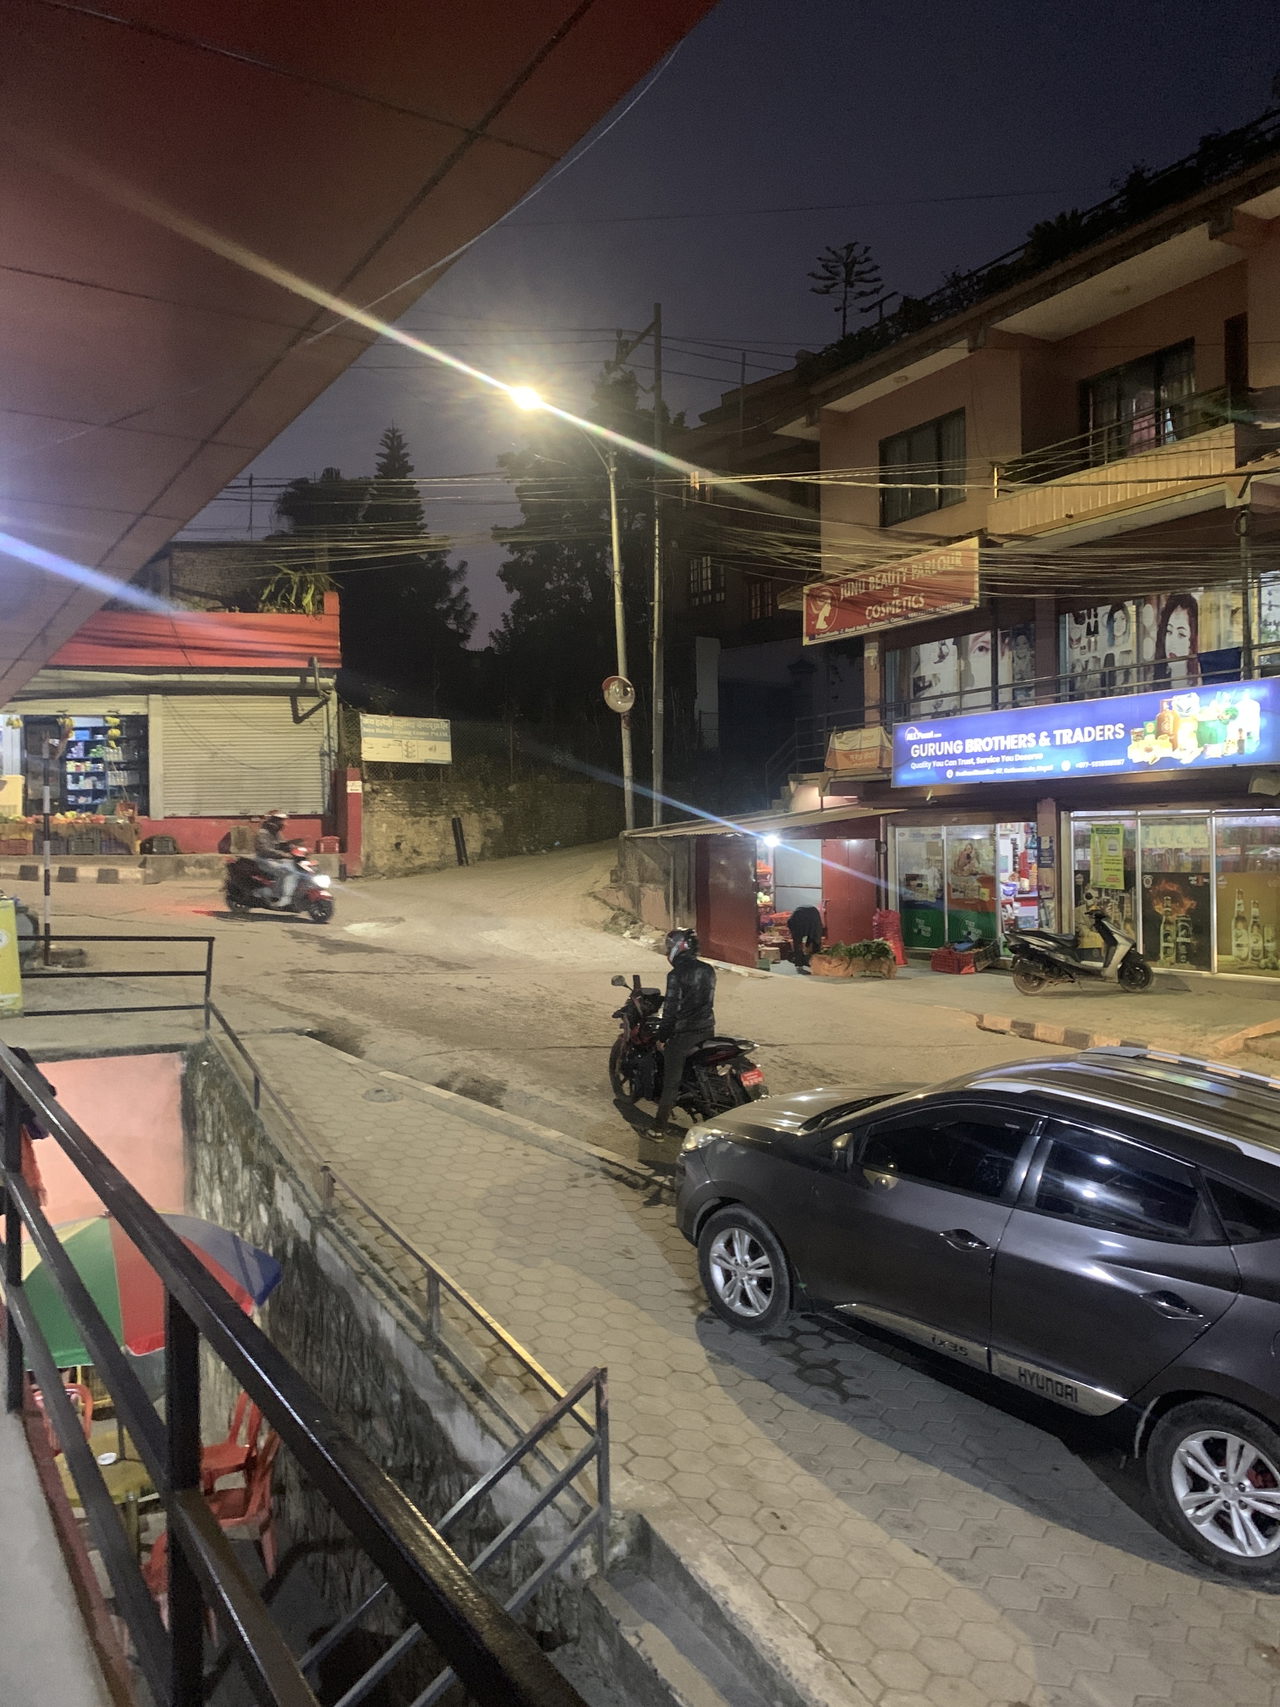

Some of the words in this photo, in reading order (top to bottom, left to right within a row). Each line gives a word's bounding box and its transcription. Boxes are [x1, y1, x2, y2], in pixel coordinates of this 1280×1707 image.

[869, 567, 908, 590] BEAUTY
[865, 594, 925, 620] COSMETICS
[910, 740, 963, 758] GURUNG
[965, 733, 1037, 753] BROTHERS
[1038, 731, 1051, 747] &
[1053, 723, 1125, 746] TRADERS
[910, 761, 932, 770] Quality
[932, 760, 944, 768] You
[944, 759, 957, 767] Can
[958, 757, 976, 767] Trust,
[976, 755, 1000, 765] Service
[1001, 754, 1014, 763] You
[930, 1333, 968, 1357] ix35
[1018, 1366, 1078, 1404] HYUNDAI
